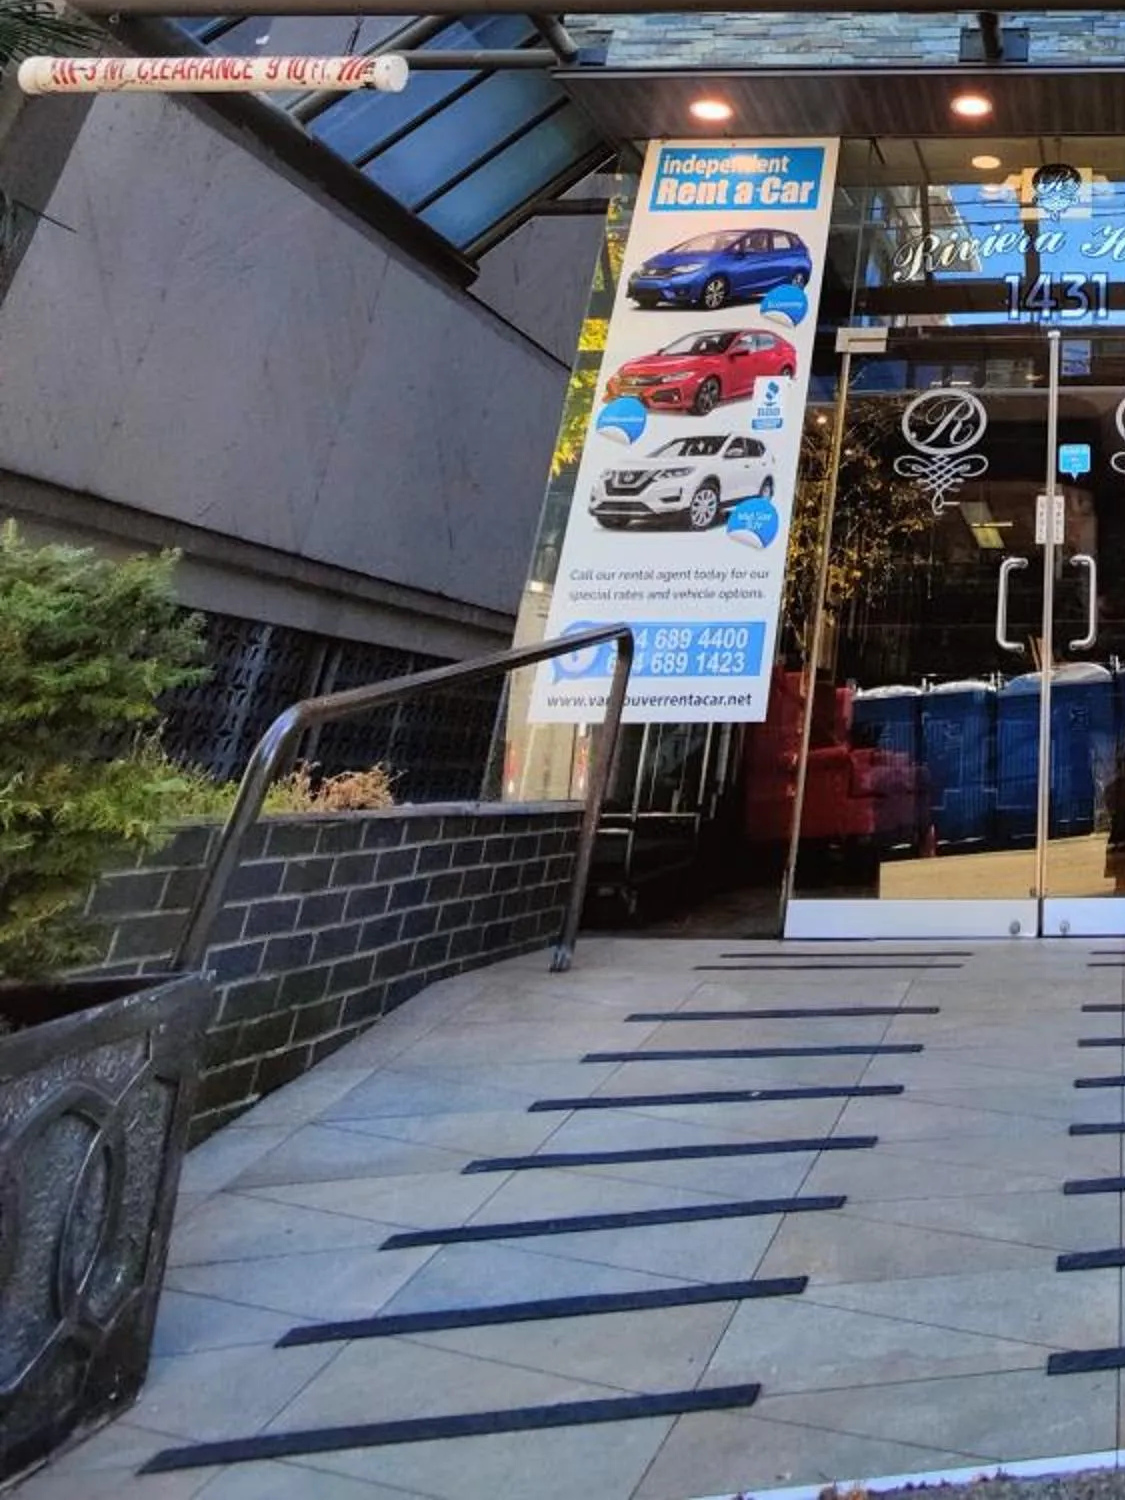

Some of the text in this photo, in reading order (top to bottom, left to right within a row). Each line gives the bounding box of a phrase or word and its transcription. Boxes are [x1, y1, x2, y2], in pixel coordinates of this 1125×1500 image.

[137, 58, 253, 81] CLEARANCE
[656, 176, 815, 205] Rent a Car
[894, 223, 1067, 284] Riviera
[1003, 272, 1111, 321] 1431
[569, 567, 769, 583] Call our rental agent today for our
[569, 588, 612, 602] special
[613, 589, 644, 601] rates
[648, 588, 672, 601] and
[673, 588, 717, 601] vehicle
[654, 628, 693, 650] 689
[697, 628, 750, 650] 4400
[651, 652, 690, 674] 689
[696, 652, 746, 674] 1423
